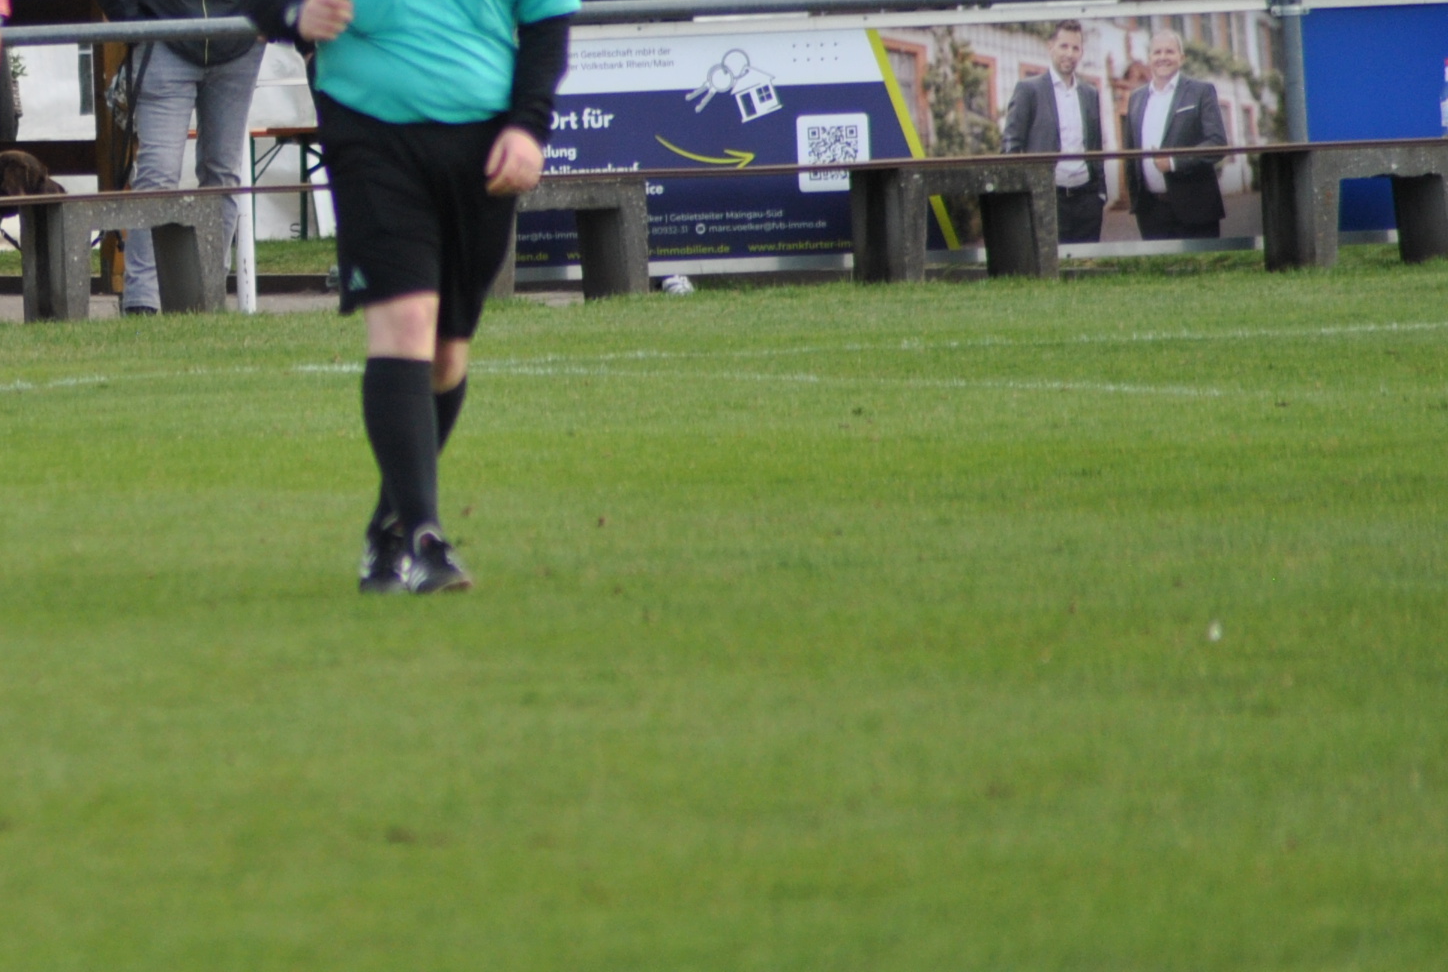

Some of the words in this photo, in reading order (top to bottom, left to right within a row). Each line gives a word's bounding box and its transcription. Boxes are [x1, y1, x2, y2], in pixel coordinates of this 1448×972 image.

[580, 48, 632, 60] Gesellschaft
[657, 46, 671, 56] der
[580, 60, 623, 70] Volksbank
[626, 58, 674, 69] Rhein/Main
[582, 107, 615, 129] für
